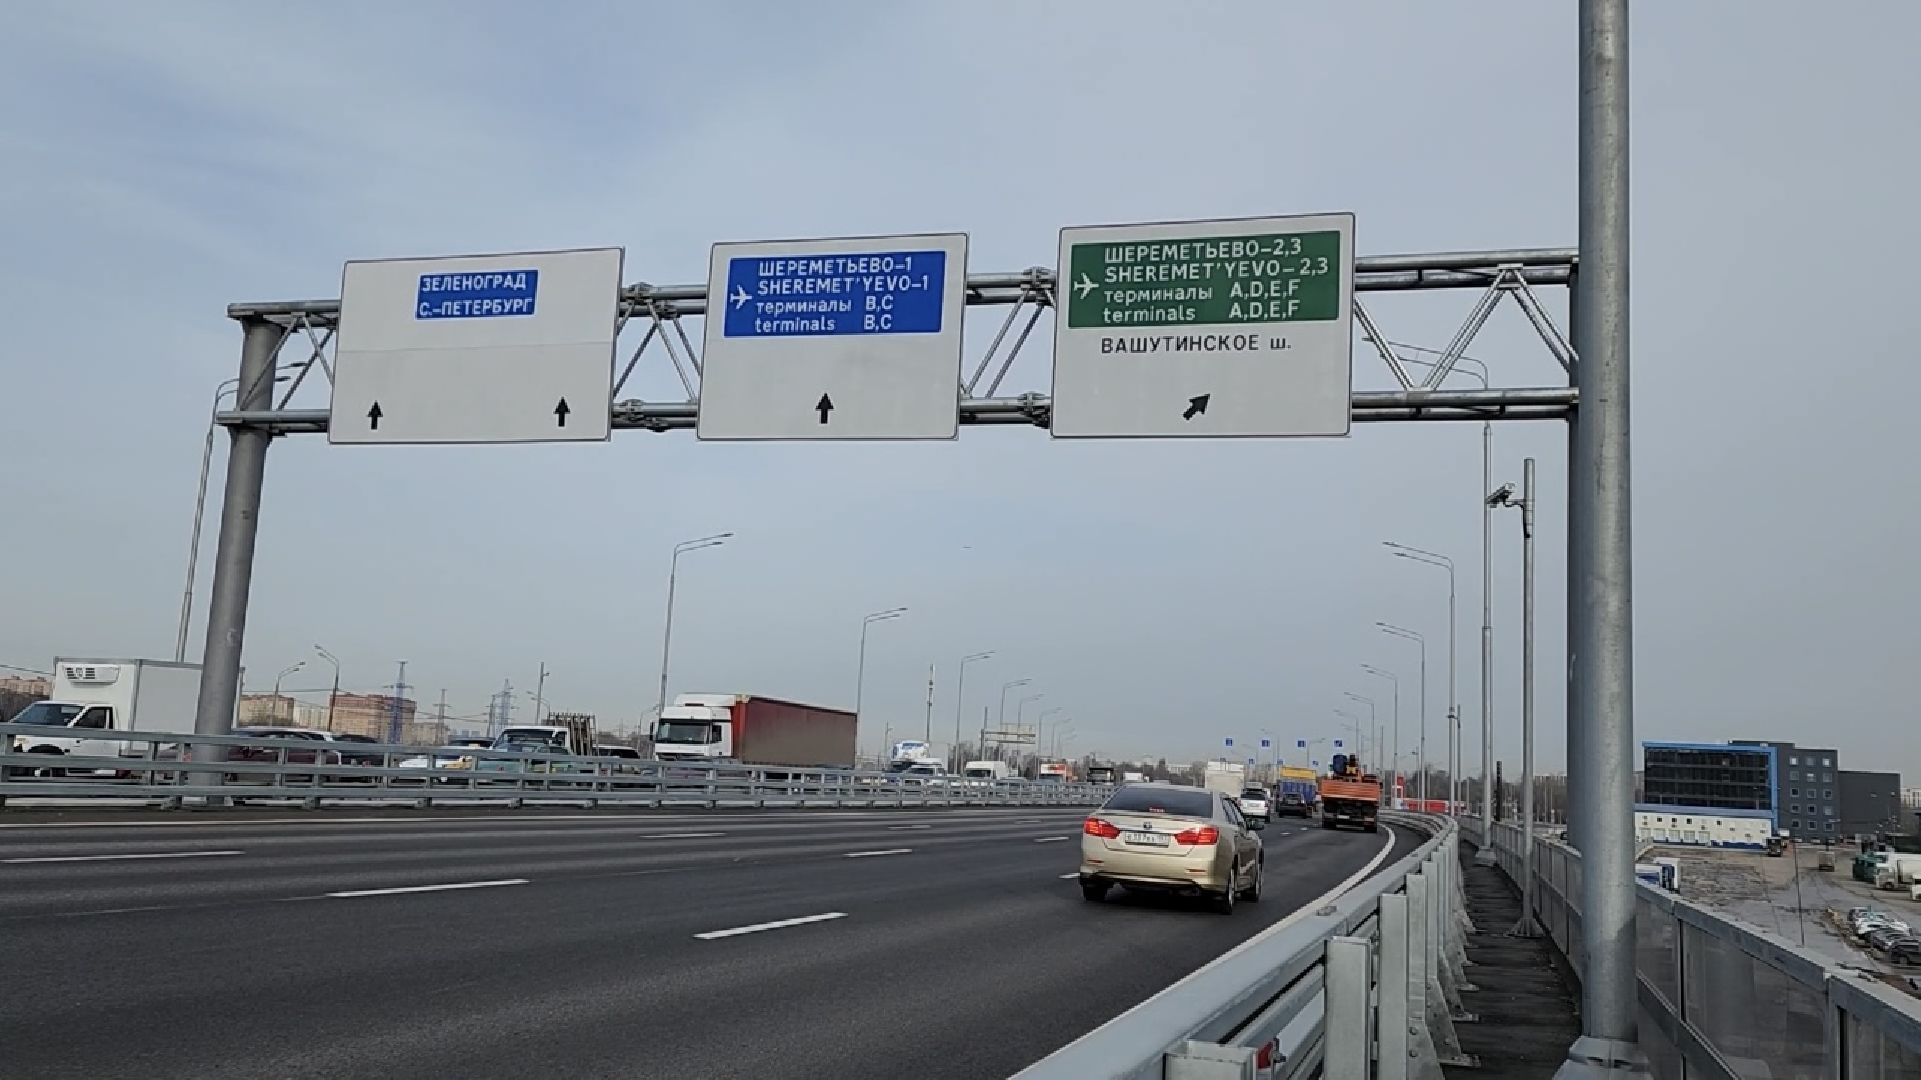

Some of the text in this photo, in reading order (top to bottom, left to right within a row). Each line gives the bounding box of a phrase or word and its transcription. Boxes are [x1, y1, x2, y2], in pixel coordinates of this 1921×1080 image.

[1104, 239, 1301, 264] ШЕРЕМЕТЬЕВО-2,3
[758, 257, 912, 276] ШЕРЕМЕТЬЕВО-1
[422, 273, 527, 291] ЗЕЛЕНОГРАД
[1104, 287, 1213, 306] терминалы
[756, 298, 852, 317] терминалы
[1103, 300, 1300, 324] terminals A,D,E,F
[755, 315, 835, 332] terminals
[1101, 334, 1291, 353] ВАШУТИНСКОЕ ш.
